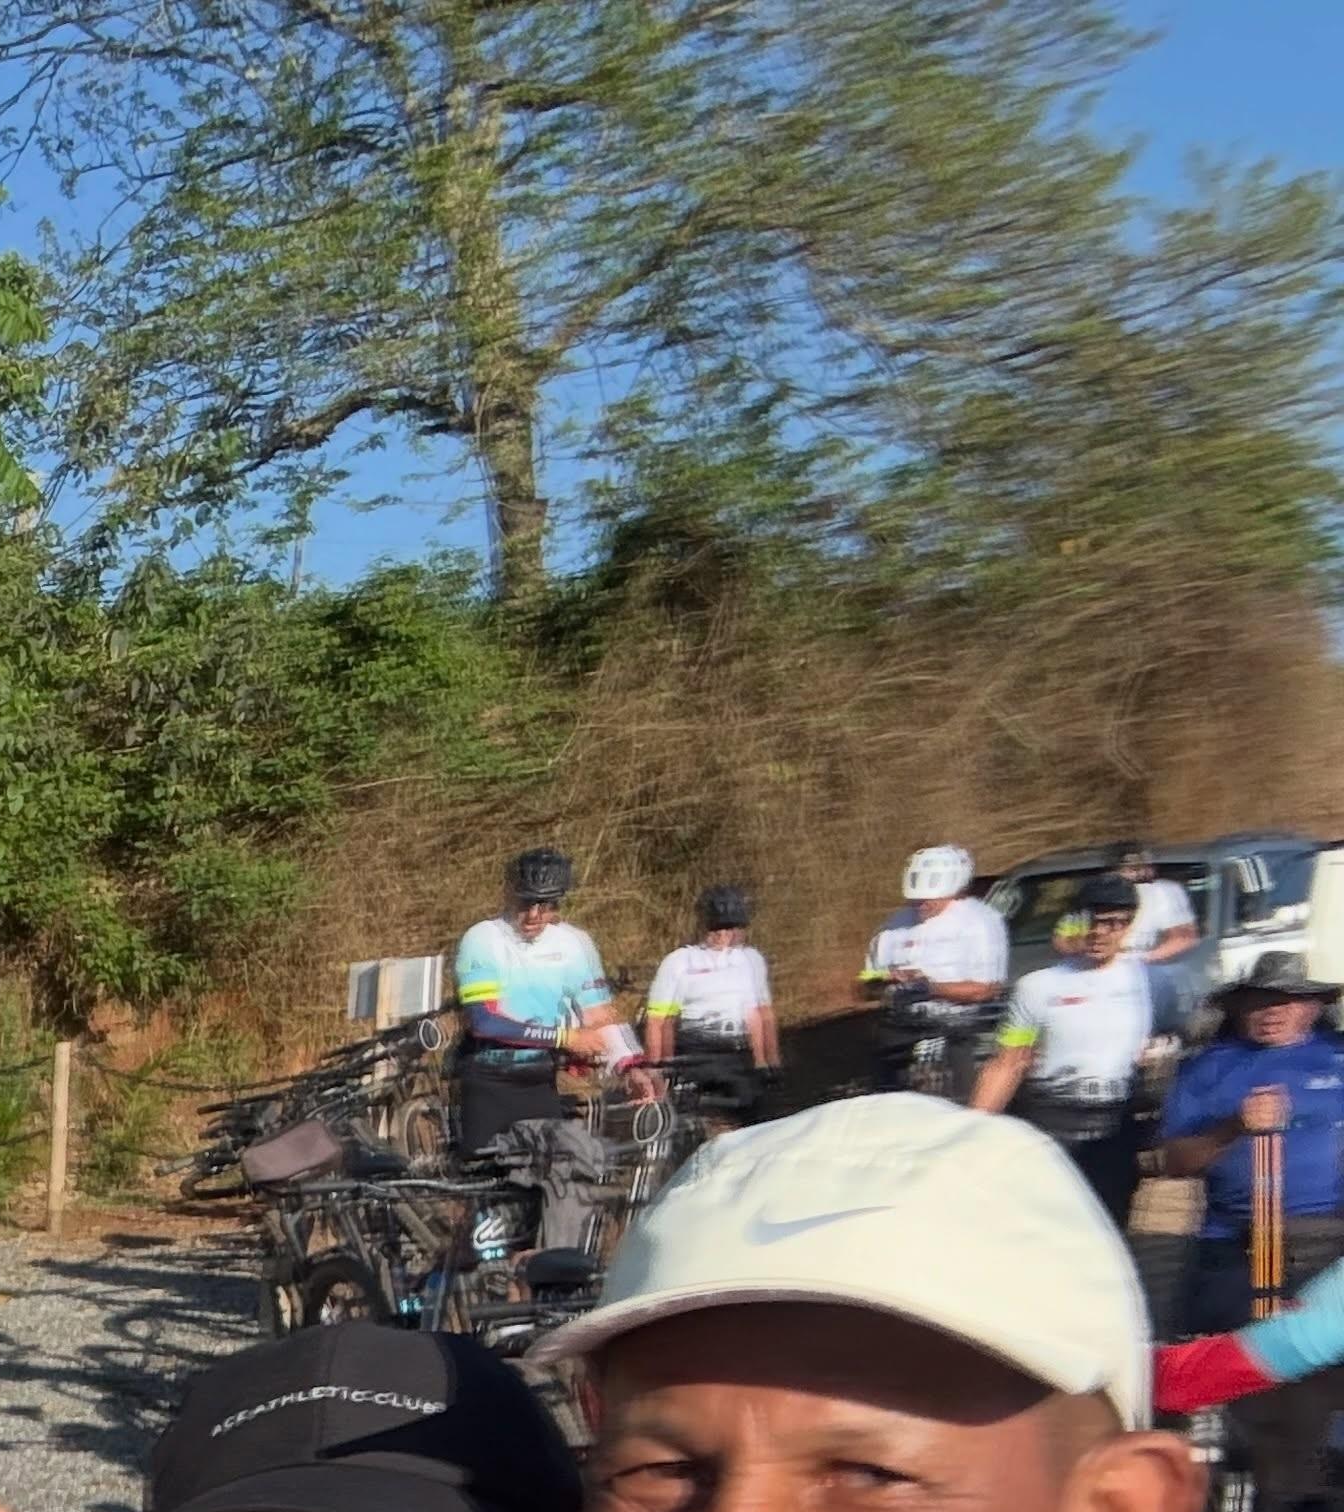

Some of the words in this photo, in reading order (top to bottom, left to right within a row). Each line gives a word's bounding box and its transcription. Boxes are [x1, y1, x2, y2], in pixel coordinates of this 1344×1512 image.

[211, 1411, 249, 1436] ACE
[250, 1386, 369, 1416] ATHLETIC
[374, 1392, 444, 1414] CLUB
